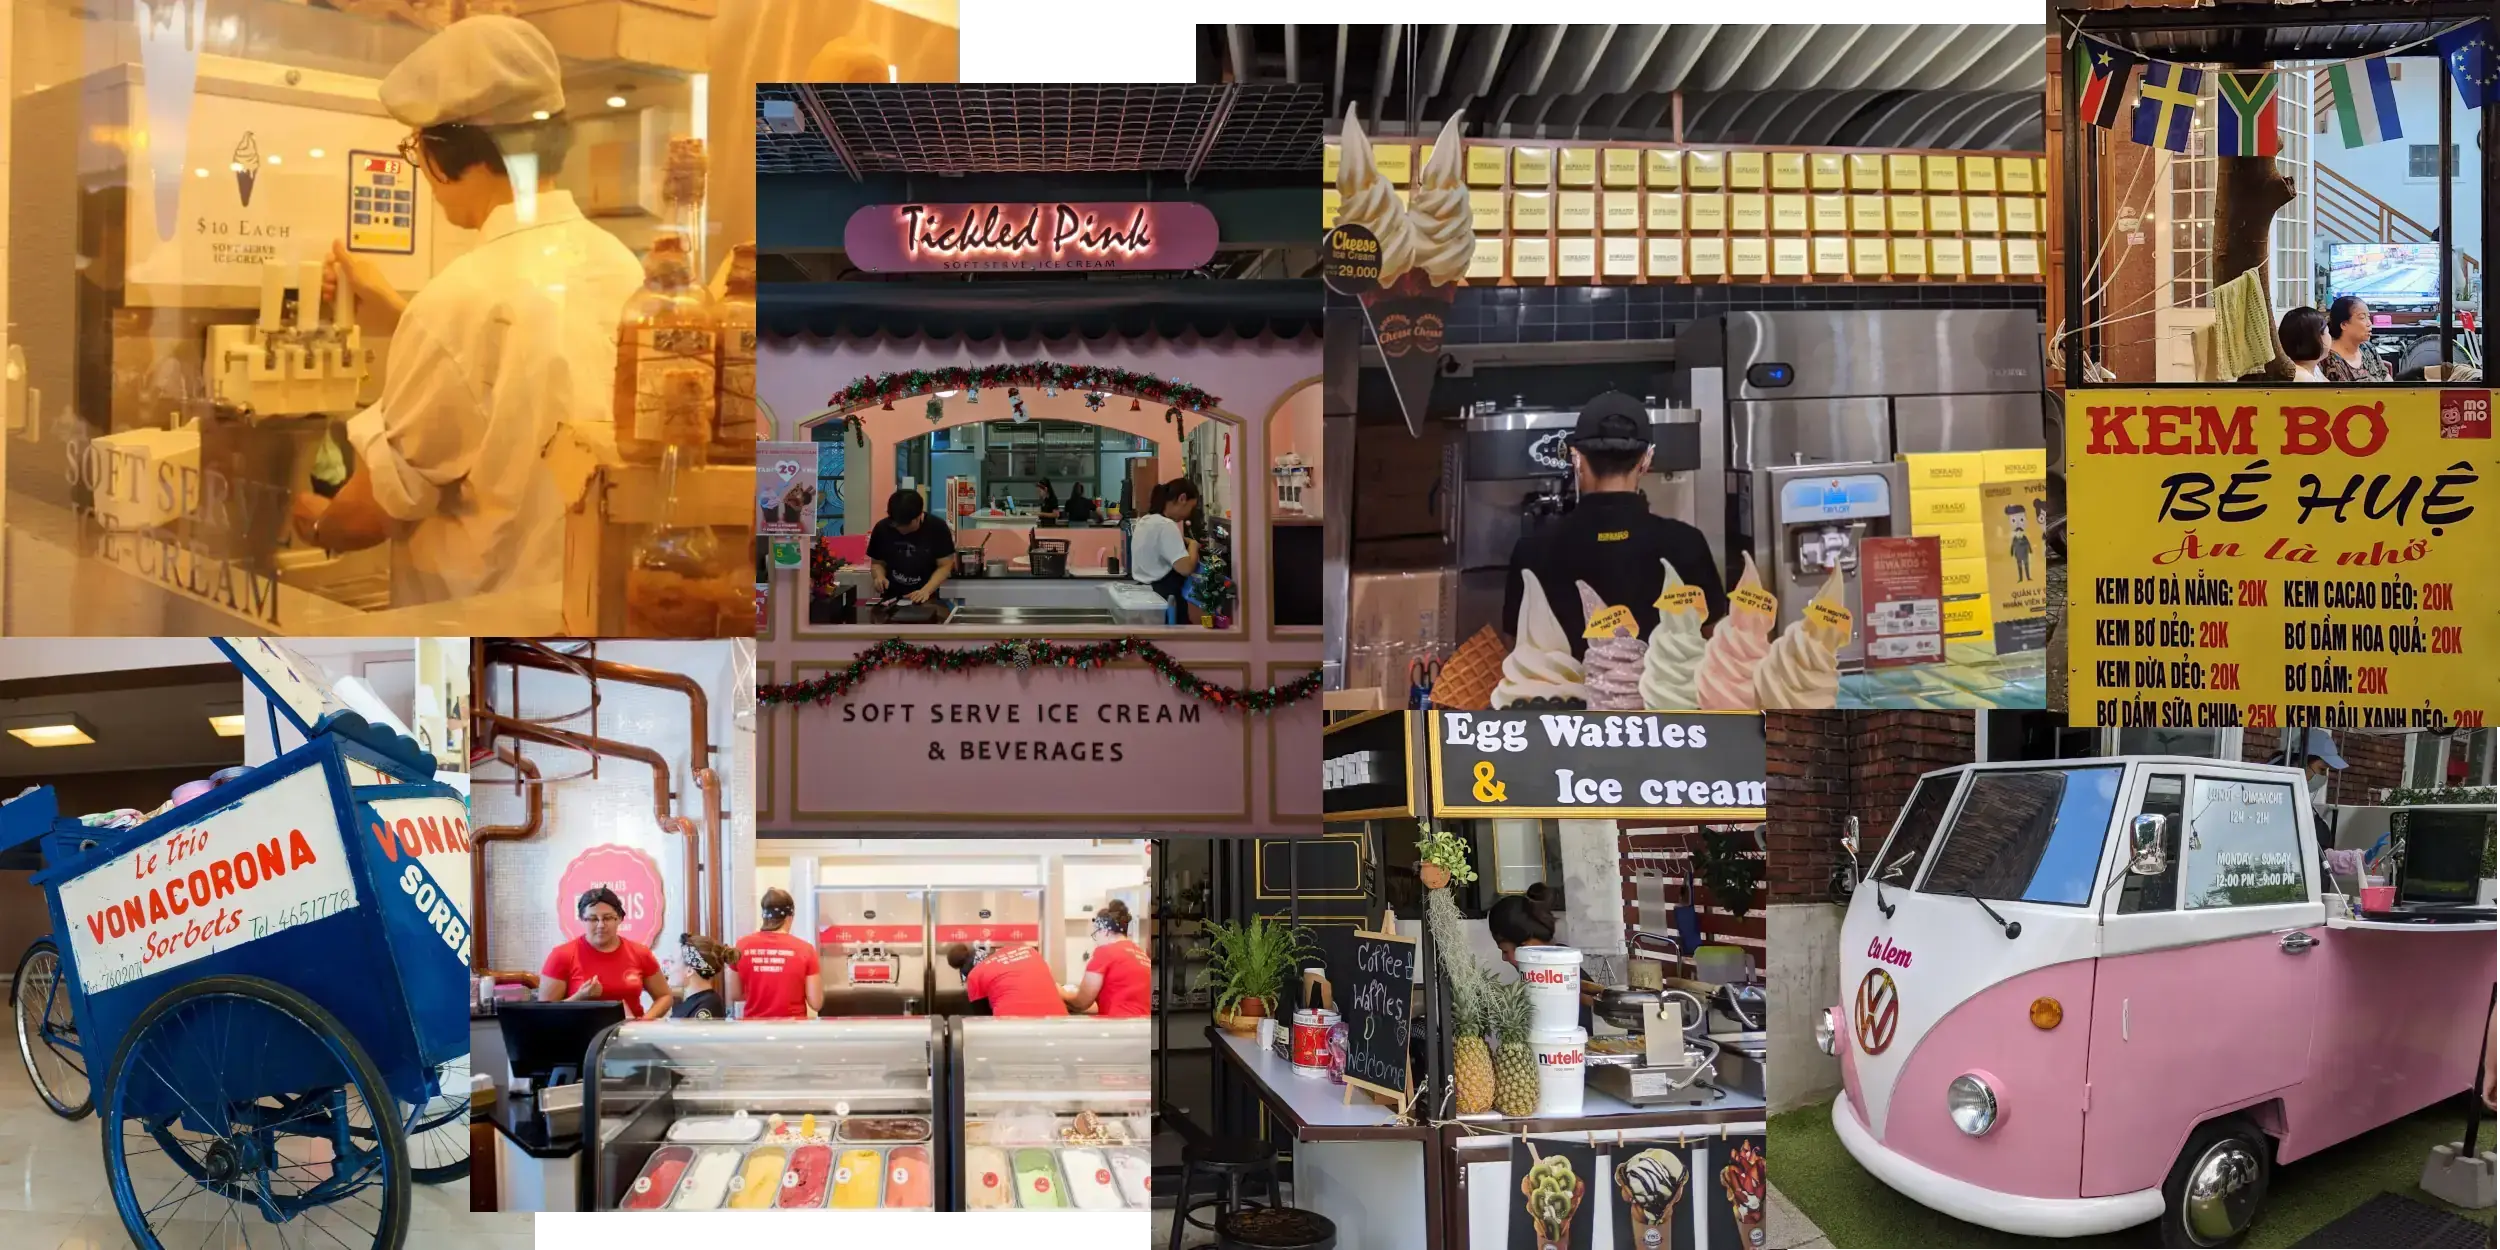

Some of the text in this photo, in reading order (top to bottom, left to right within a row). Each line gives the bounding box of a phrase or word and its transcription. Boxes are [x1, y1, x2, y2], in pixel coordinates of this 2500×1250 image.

[902, 203, 1151, 252] Tickled Pink
[1332, 231, 1378, 253] Cheese
[944, 262, 978, 270] SOFT
[984, 261, 1026, 269] SERVE
[1066, 260, 1115, 268] CREAM
[1333, 251, 1376, 262] Ice Cream
[1339, 265, 1378, 279] 29,000
[1379, 328, 1411, 344] Cheese
[2086, 401, 2389, 457] KEM BƠ
[66, 440, 146, 504] SOFT
[779, 465, 797, 476] 29
[2158, 459, 2479, 537] BÉ HUỆ
[72, 503, 281, 627] ICE-CREAM
[2152, 528, 2245, 565] Ăn
[2264, 537, 2319, 563] là
[2096, 568, 2268, 607] KEM BƠ ĐÀ NẴNG: 20K
[2284, 573, 2453, 610] KEM CACAO DẺO: 20K
[1761, 603, 1773, 612] CN
[2096, 611, 2229, 648] KEM BƠ DẺO: 20K
[2285, 614, 2462, 655] BƠ DẦM HOA QUẢ: 20K
[2097, 653, 2240, 690] KEM DỪA DẺO: 20K
[2285, 656, 2388, 694] BƠ DẦM: 20K
[843, 703, 1201, 723] SOFT SERVE ICE CREAM
[2097, 691, 2277, 727] BƠ DẦM SỮA CHUA: 25K
[2286, 704, 2321, 727] KEM
[2363, 707, 2407, 727] XANH
[2453, 710, 2484, 727] 20K
[1444, 712, 1707, 752] Egg Waffles
[928, 742, 1124, 761] & BEVERAGES
[1472, 761, 1766, 805] & Ice cream
[2243, 791, 2283, 804] DIMANCHE
[2230, 811, 2270, 824] 12H 21H
[136, 828, 209, 879] Le Trio
[371, 815, 470, 862] VONAC
[2217, 852, 2291, 865] MONDAY SUNDAY
[87, 829, 316, 945] VONACORONA
[2216, 874, 2239, 887] 12:00
[2241, 874, 2254, 887] PM
[2283, 873, 2295, 885] PM
[142, 907, 244, 964] Sorbets
[1358, 941, 1403, 978] Coffee
[1353, 979, 1403, 1021] Waffles
[1347, 1040, 1405, 1091] Welcome
